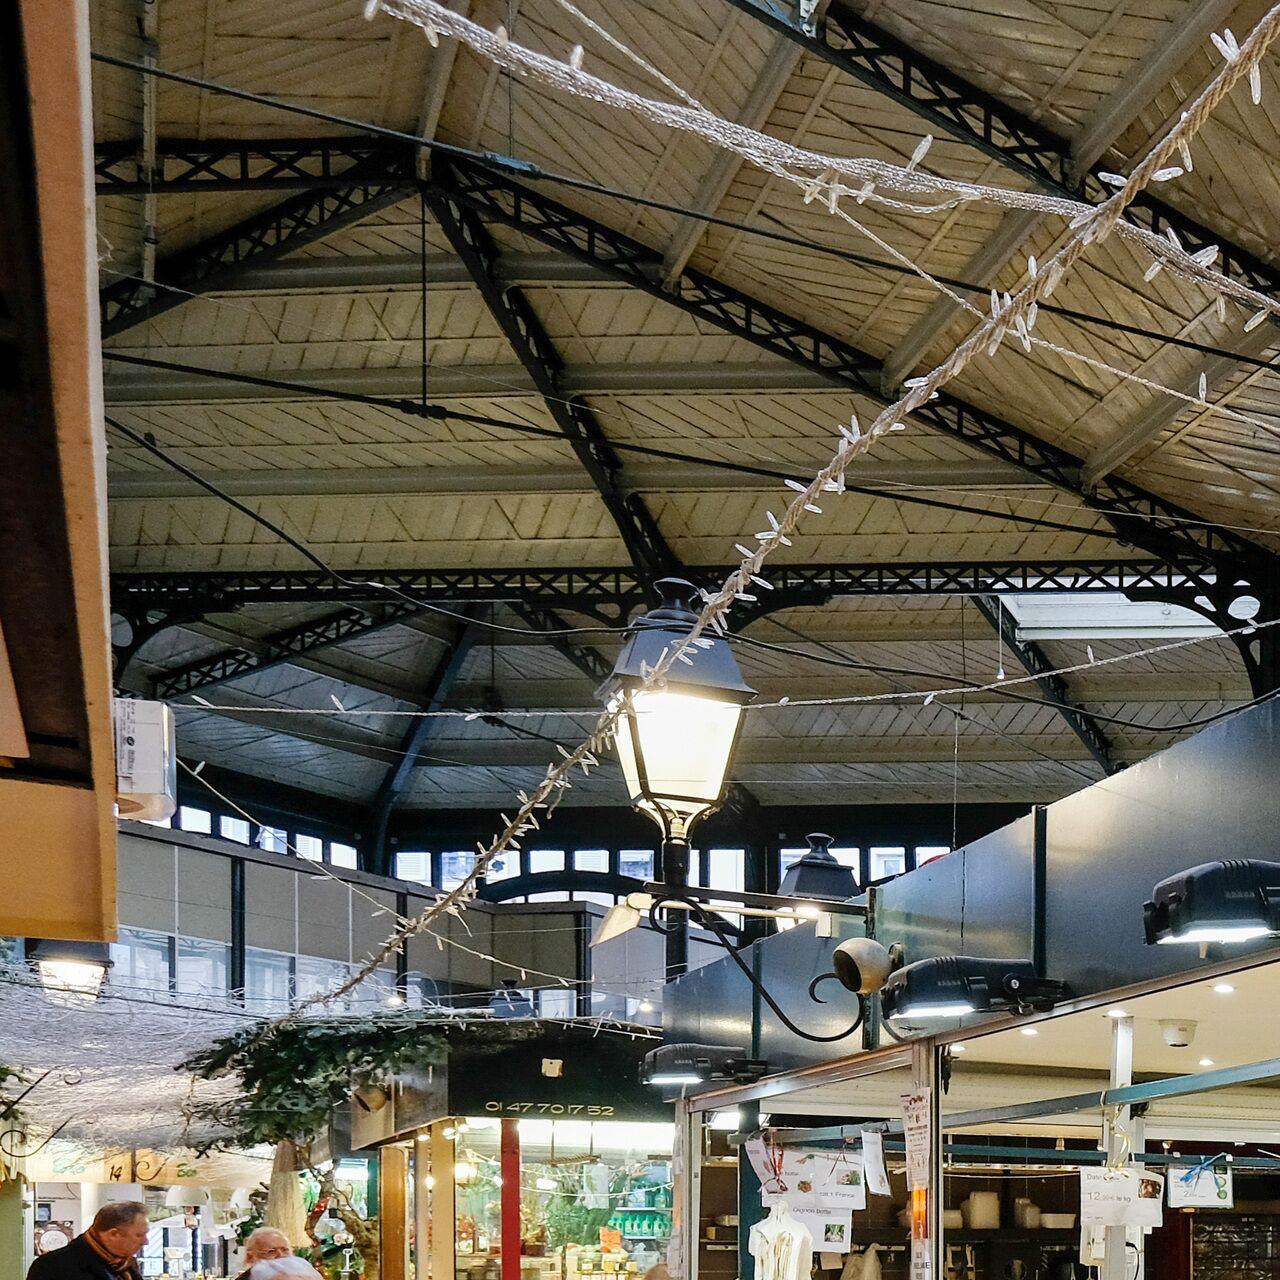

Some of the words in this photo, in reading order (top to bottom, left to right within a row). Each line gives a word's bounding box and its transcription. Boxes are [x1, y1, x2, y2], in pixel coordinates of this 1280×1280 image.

[507, 1102, 534, 1112] 47
[537, 1104, 565, 1114] 70
[587, 1105, 615, 1116] 52
